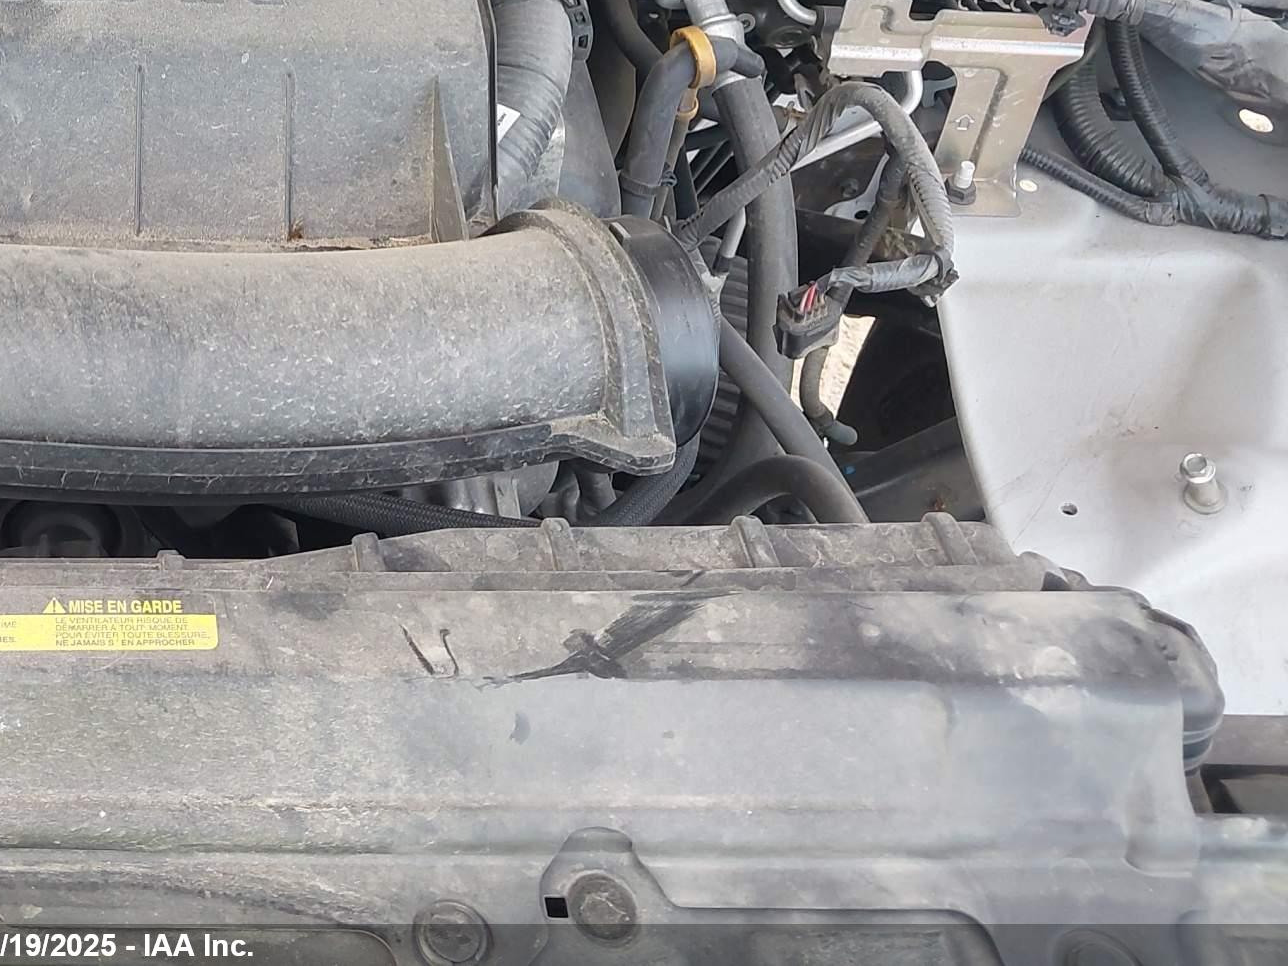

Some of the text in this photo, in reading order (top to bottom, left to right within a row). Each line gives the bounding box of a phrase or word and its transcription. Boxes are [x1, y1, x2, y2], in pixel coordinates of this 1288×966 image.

[68, 599, 183, 614] MISE EN GARDE
[55, 631, 82, 639] POUR
[121, 631, 153, 639] TOUTE
[55, 639, 69, 647] NE
[70, 639, 106, 647] JAMAIS
[121, 639, 134, 647] EN
[136, 639, 196, 647] APPROCHER
